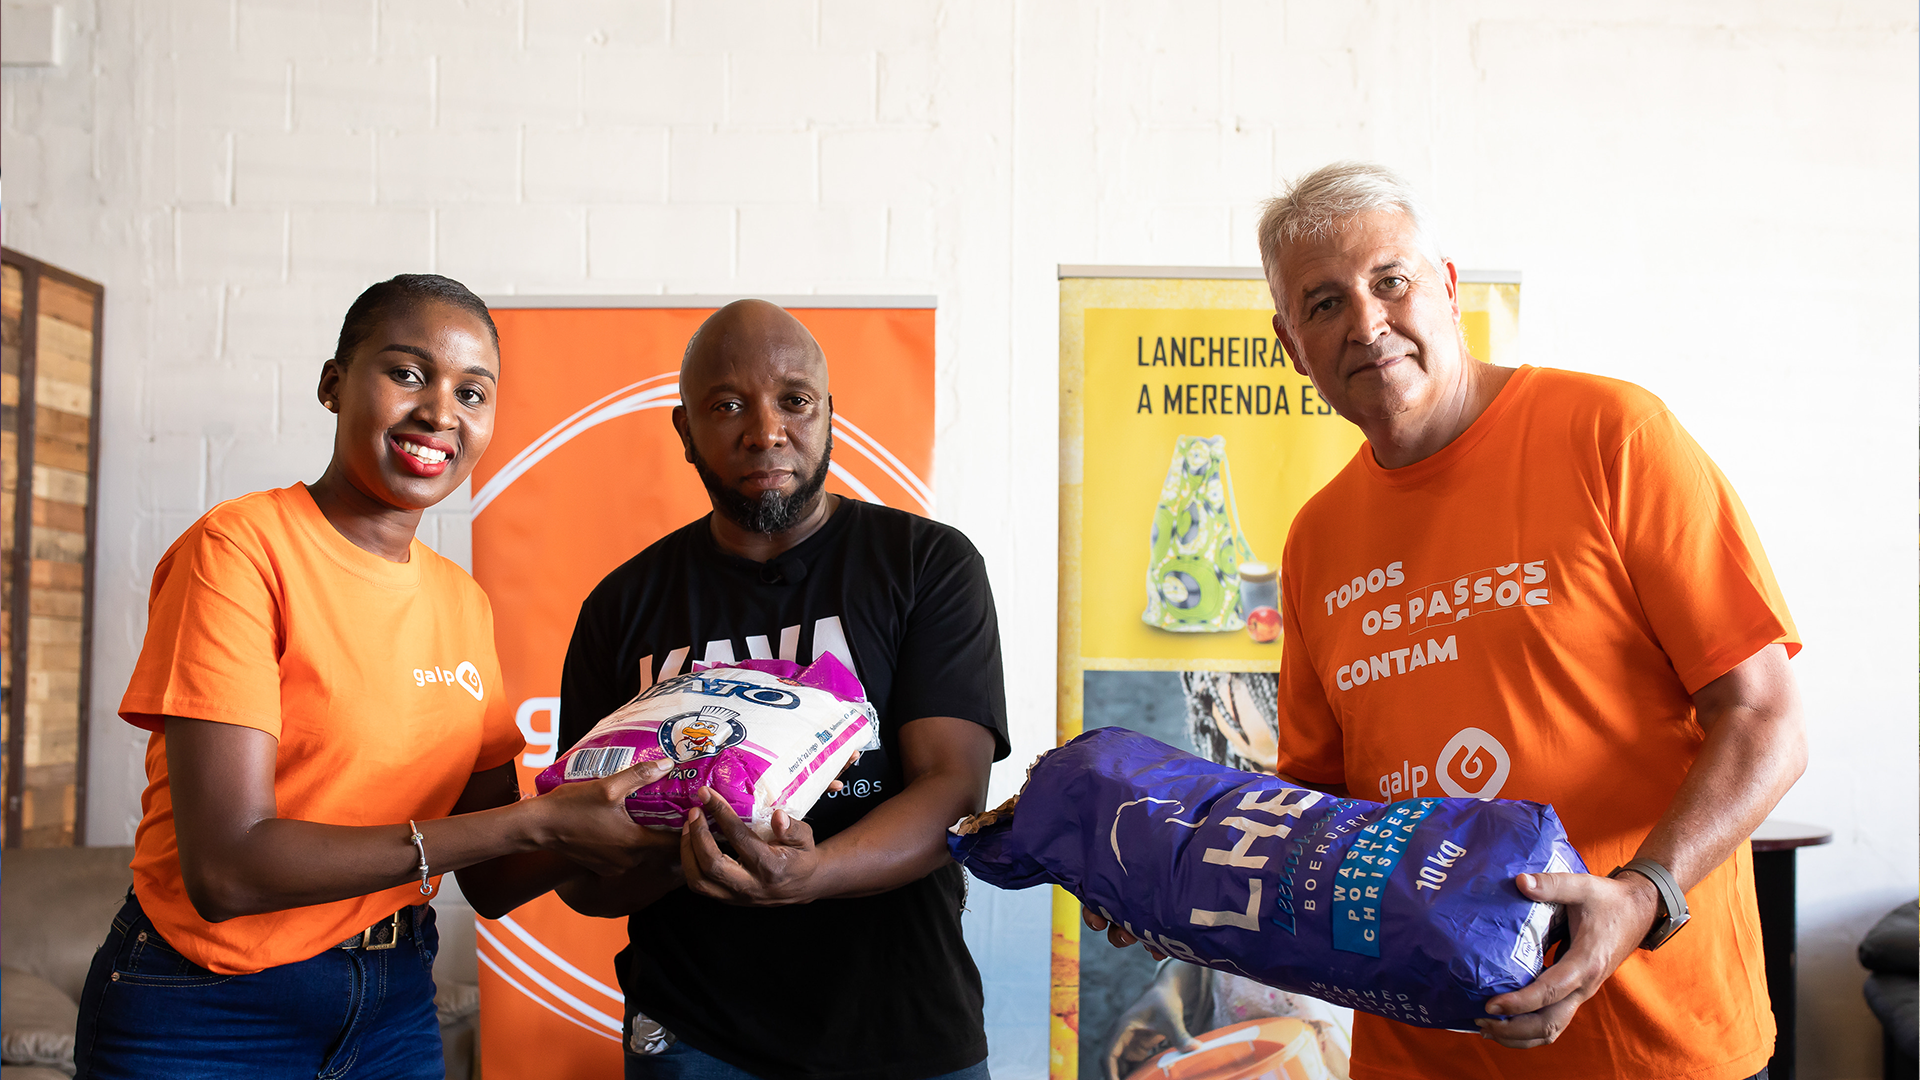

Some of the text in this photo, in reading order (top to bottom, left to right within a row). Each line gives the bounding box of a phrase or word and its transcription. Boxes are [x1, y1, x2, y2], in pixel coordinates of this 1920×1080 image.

[1137, 336, 1286, 367] LANCHEIRA
[1136, 384, 1340, 415] A MERENDA ES
[1324, 561, 1405, 616] TODOS
[1362, 604, 1402, 636] OS
[413, 666, 455, 687] galp
[1336, 635, 1458, 691] CONTAM
[667, 767, 698, 781] PATO
[1379, 760, 1428, 805] galp
[1190, 788, 1324, 932] LHB
[1304, 813, 1369, 911] BOERDERY
[1334, 815, 1386, 902] WASHE
[1348, 807, 1410, 921] POTATOES
[1363, 799, 1434, 942] CHRISTIANA
